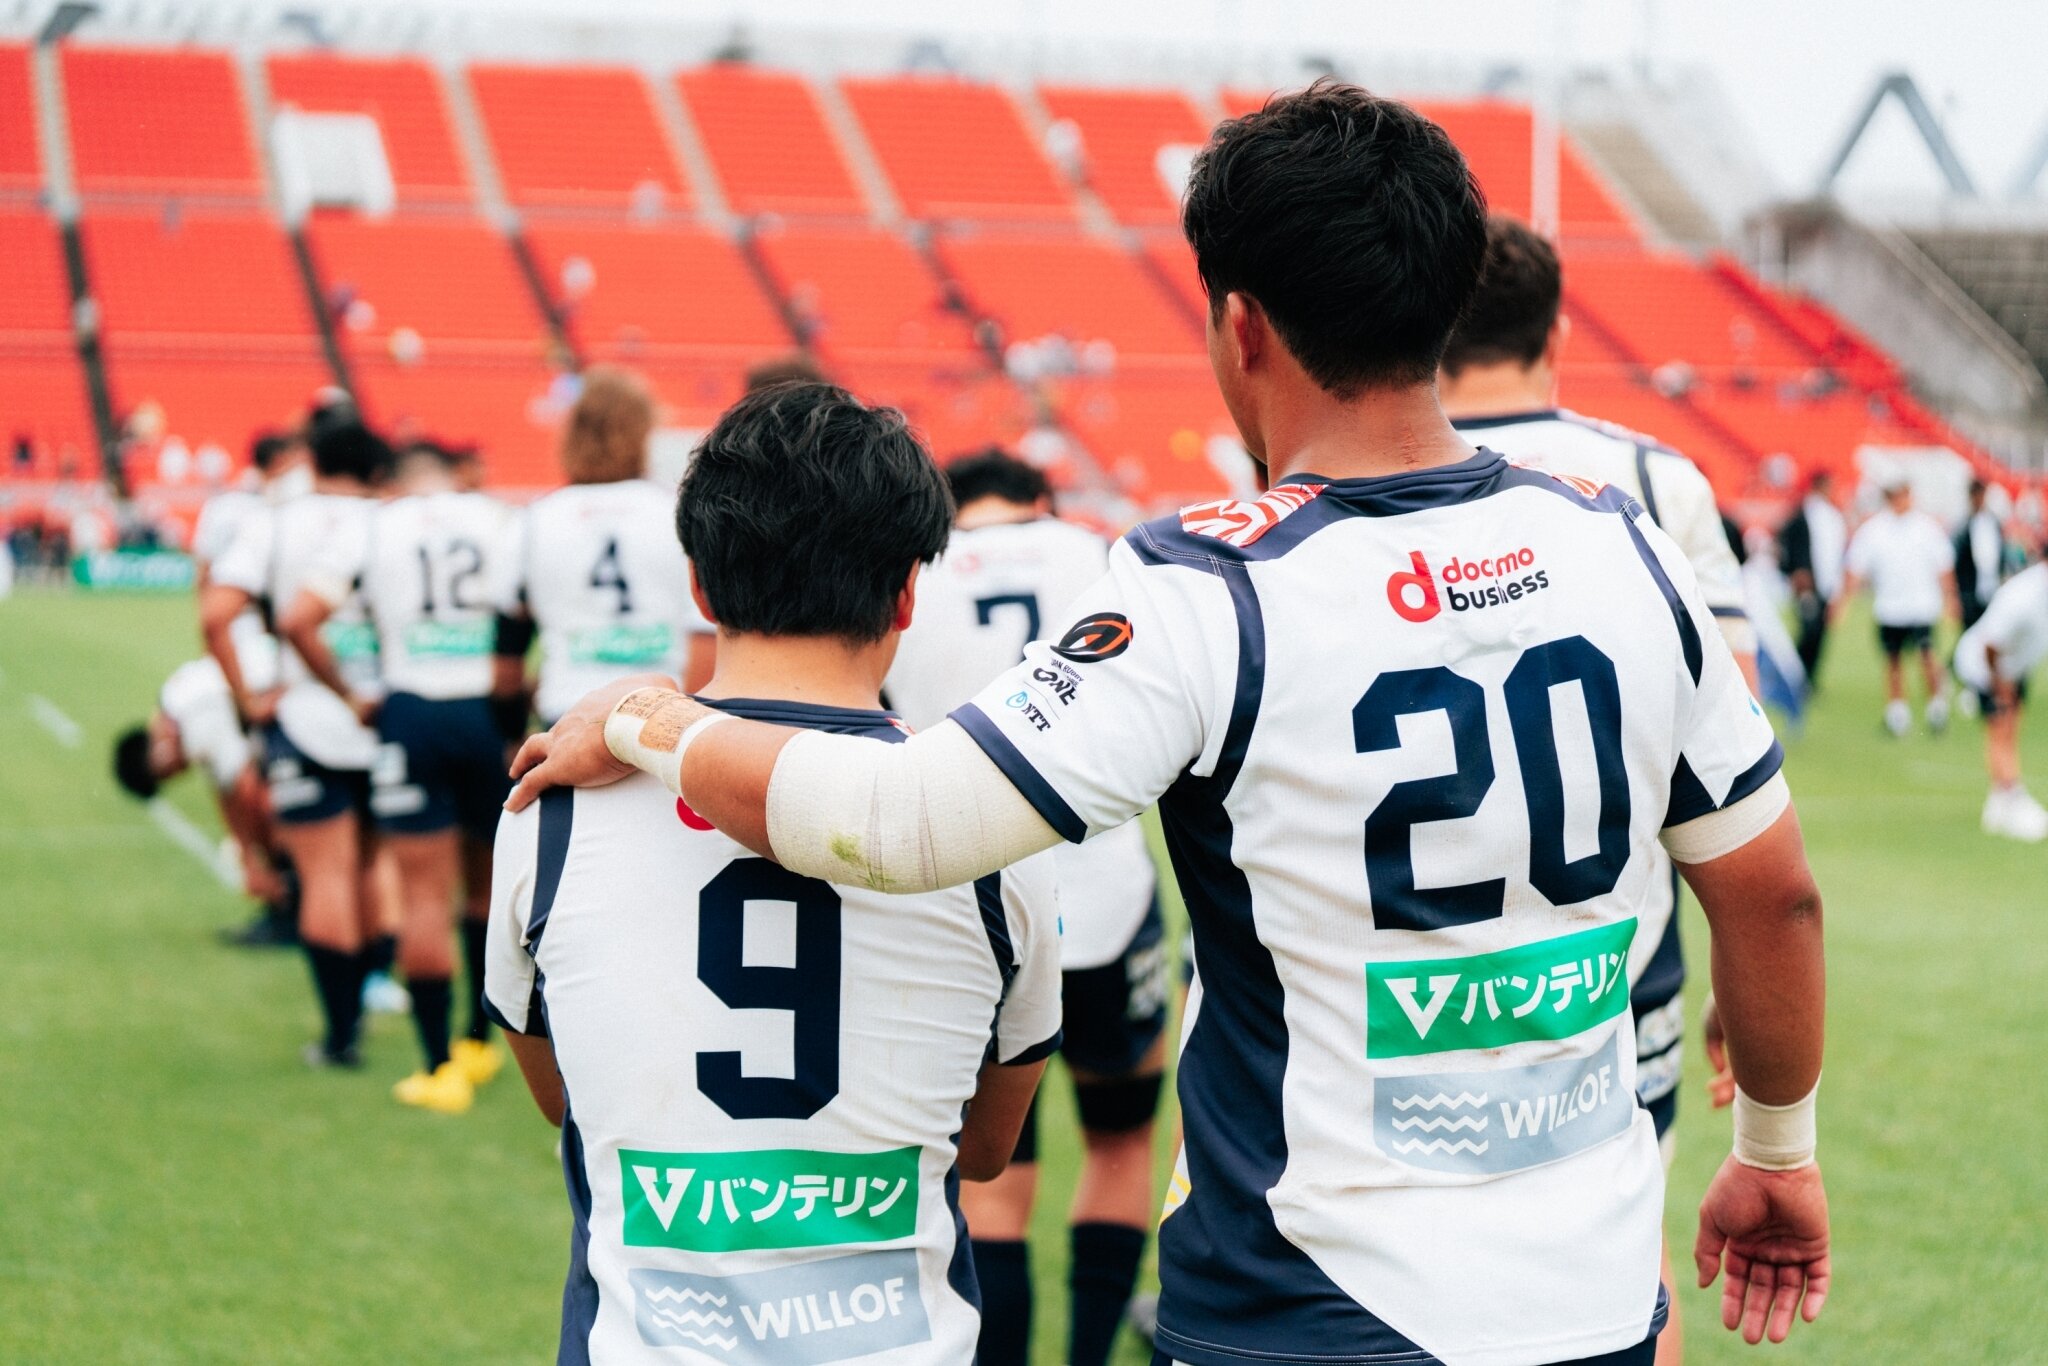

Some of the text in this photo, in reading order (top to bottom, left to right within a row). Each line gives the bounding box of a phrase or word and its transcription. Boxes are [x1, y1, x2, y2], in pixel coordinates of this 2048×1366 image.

[416, 538, 497, 614] 12
[588, 537, 632, 613] 4
[1442, 547, 1535, 583] docmo
[1021, 703, 1051, 732] NTT
[1033, 667, 1077, 706] ONE
[1352, 634, 1631, 930] 20
[696, 857, 842, 1120] 9
[1460, 949, 1626, 1026] バンテリン
[1500, 1064, 1611, 1139] WILLOF
[697, 1174, 908, 1224] バンテリン
[739, 1277, 905, 1341] WILLOF
